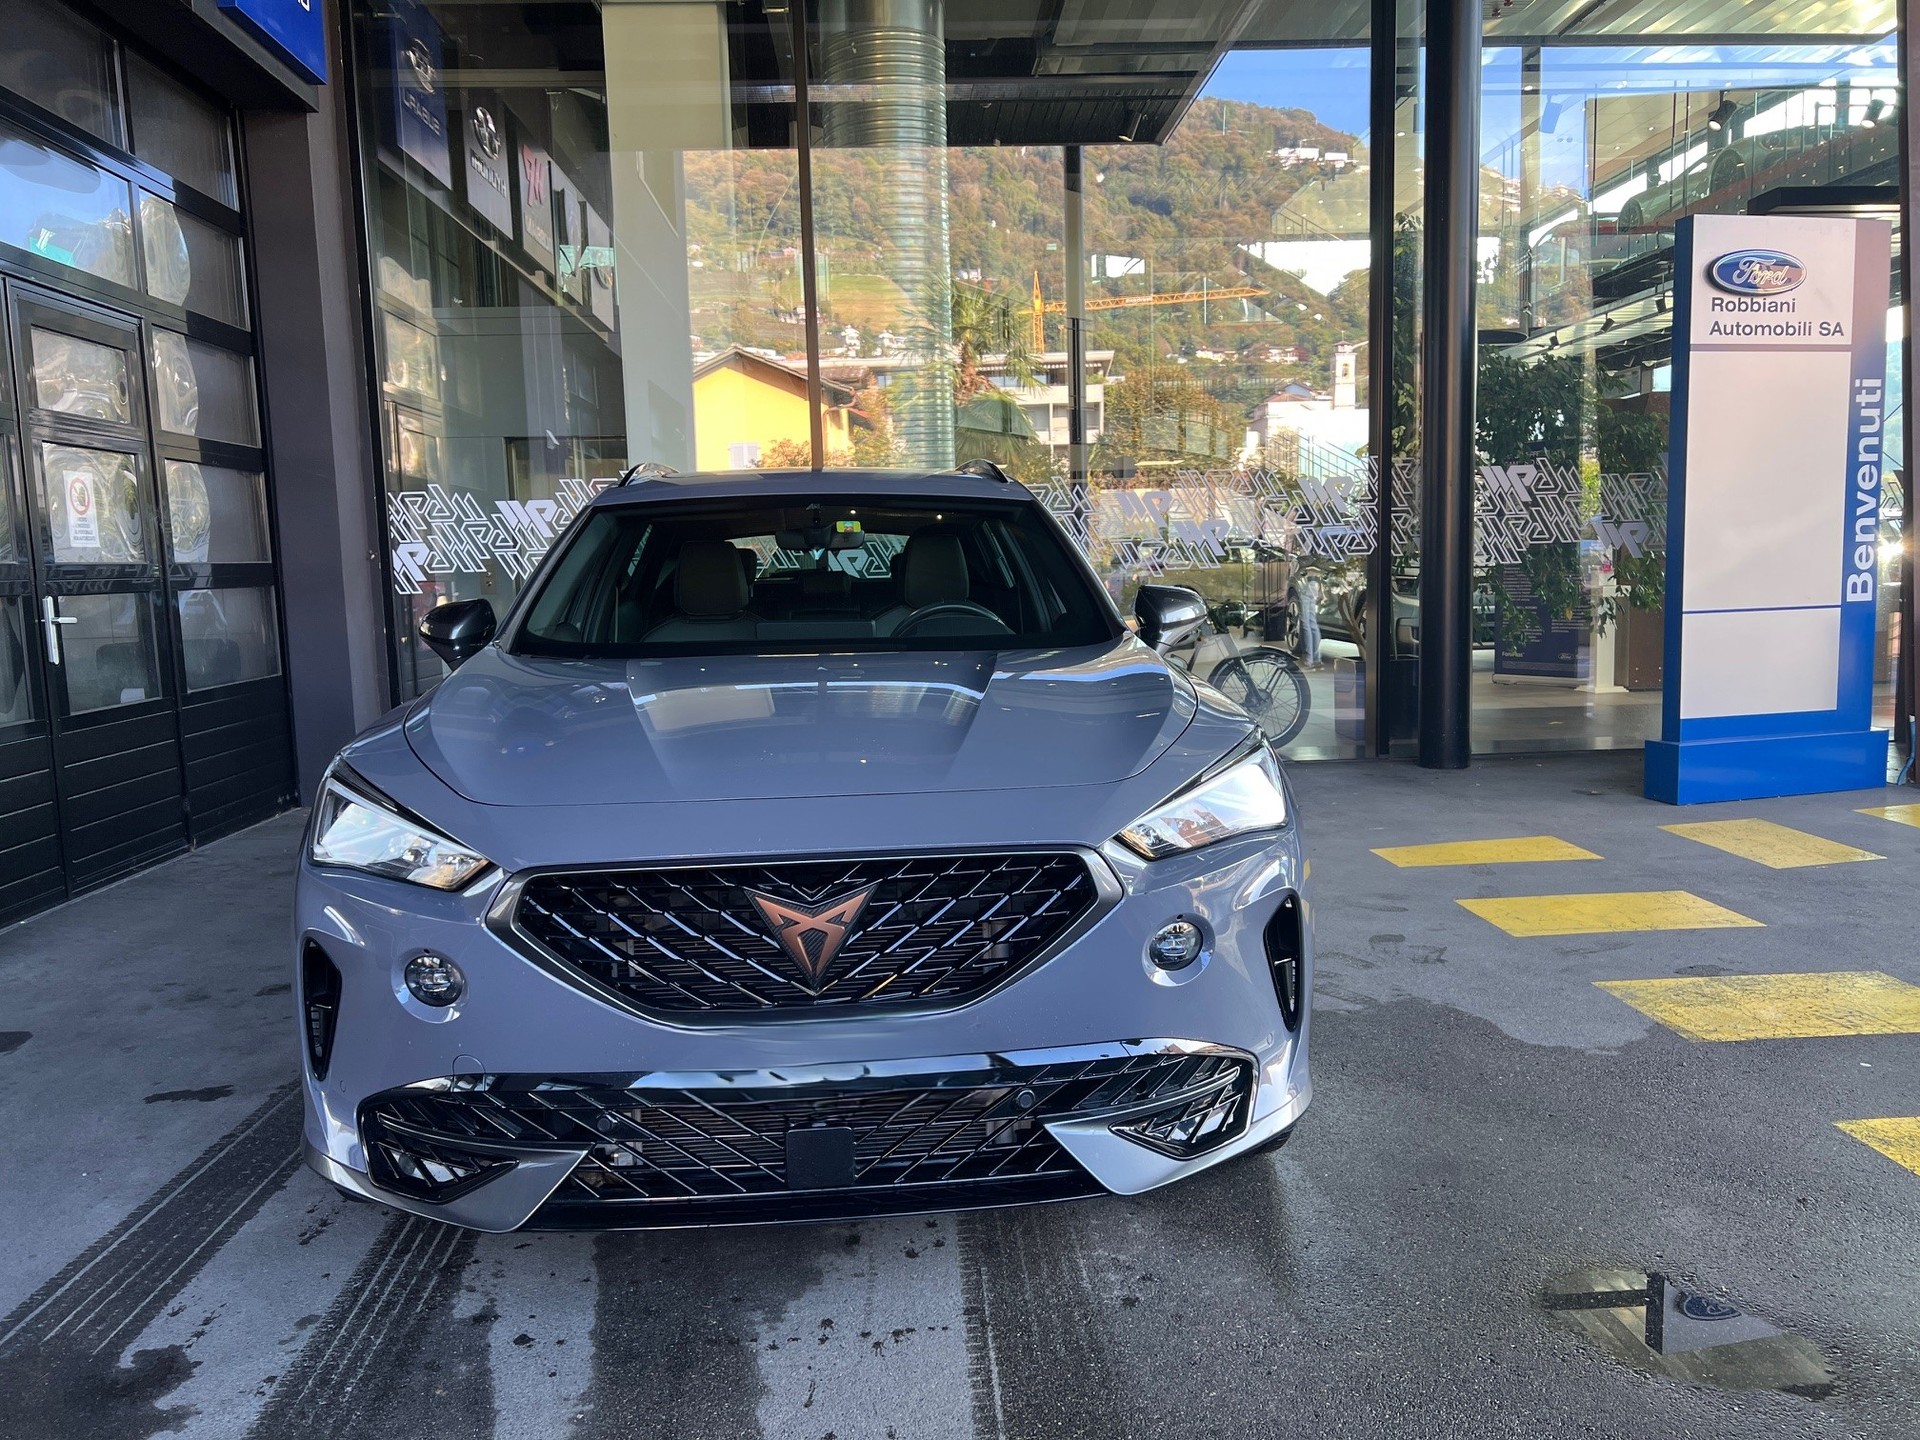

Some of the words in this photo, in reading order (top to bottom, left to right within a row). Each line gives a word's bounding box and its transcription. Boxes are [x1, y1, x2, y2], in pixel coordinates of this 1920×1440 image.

[1732, 256, 1790, 286] Ford
[1711, 297, 1796, 313] Robbiani
[1709, 320, 1812, 337] Automobili
[1818, 321, 1845, 337] SA
[1846, 378, 1882, 602] Benvenuti
